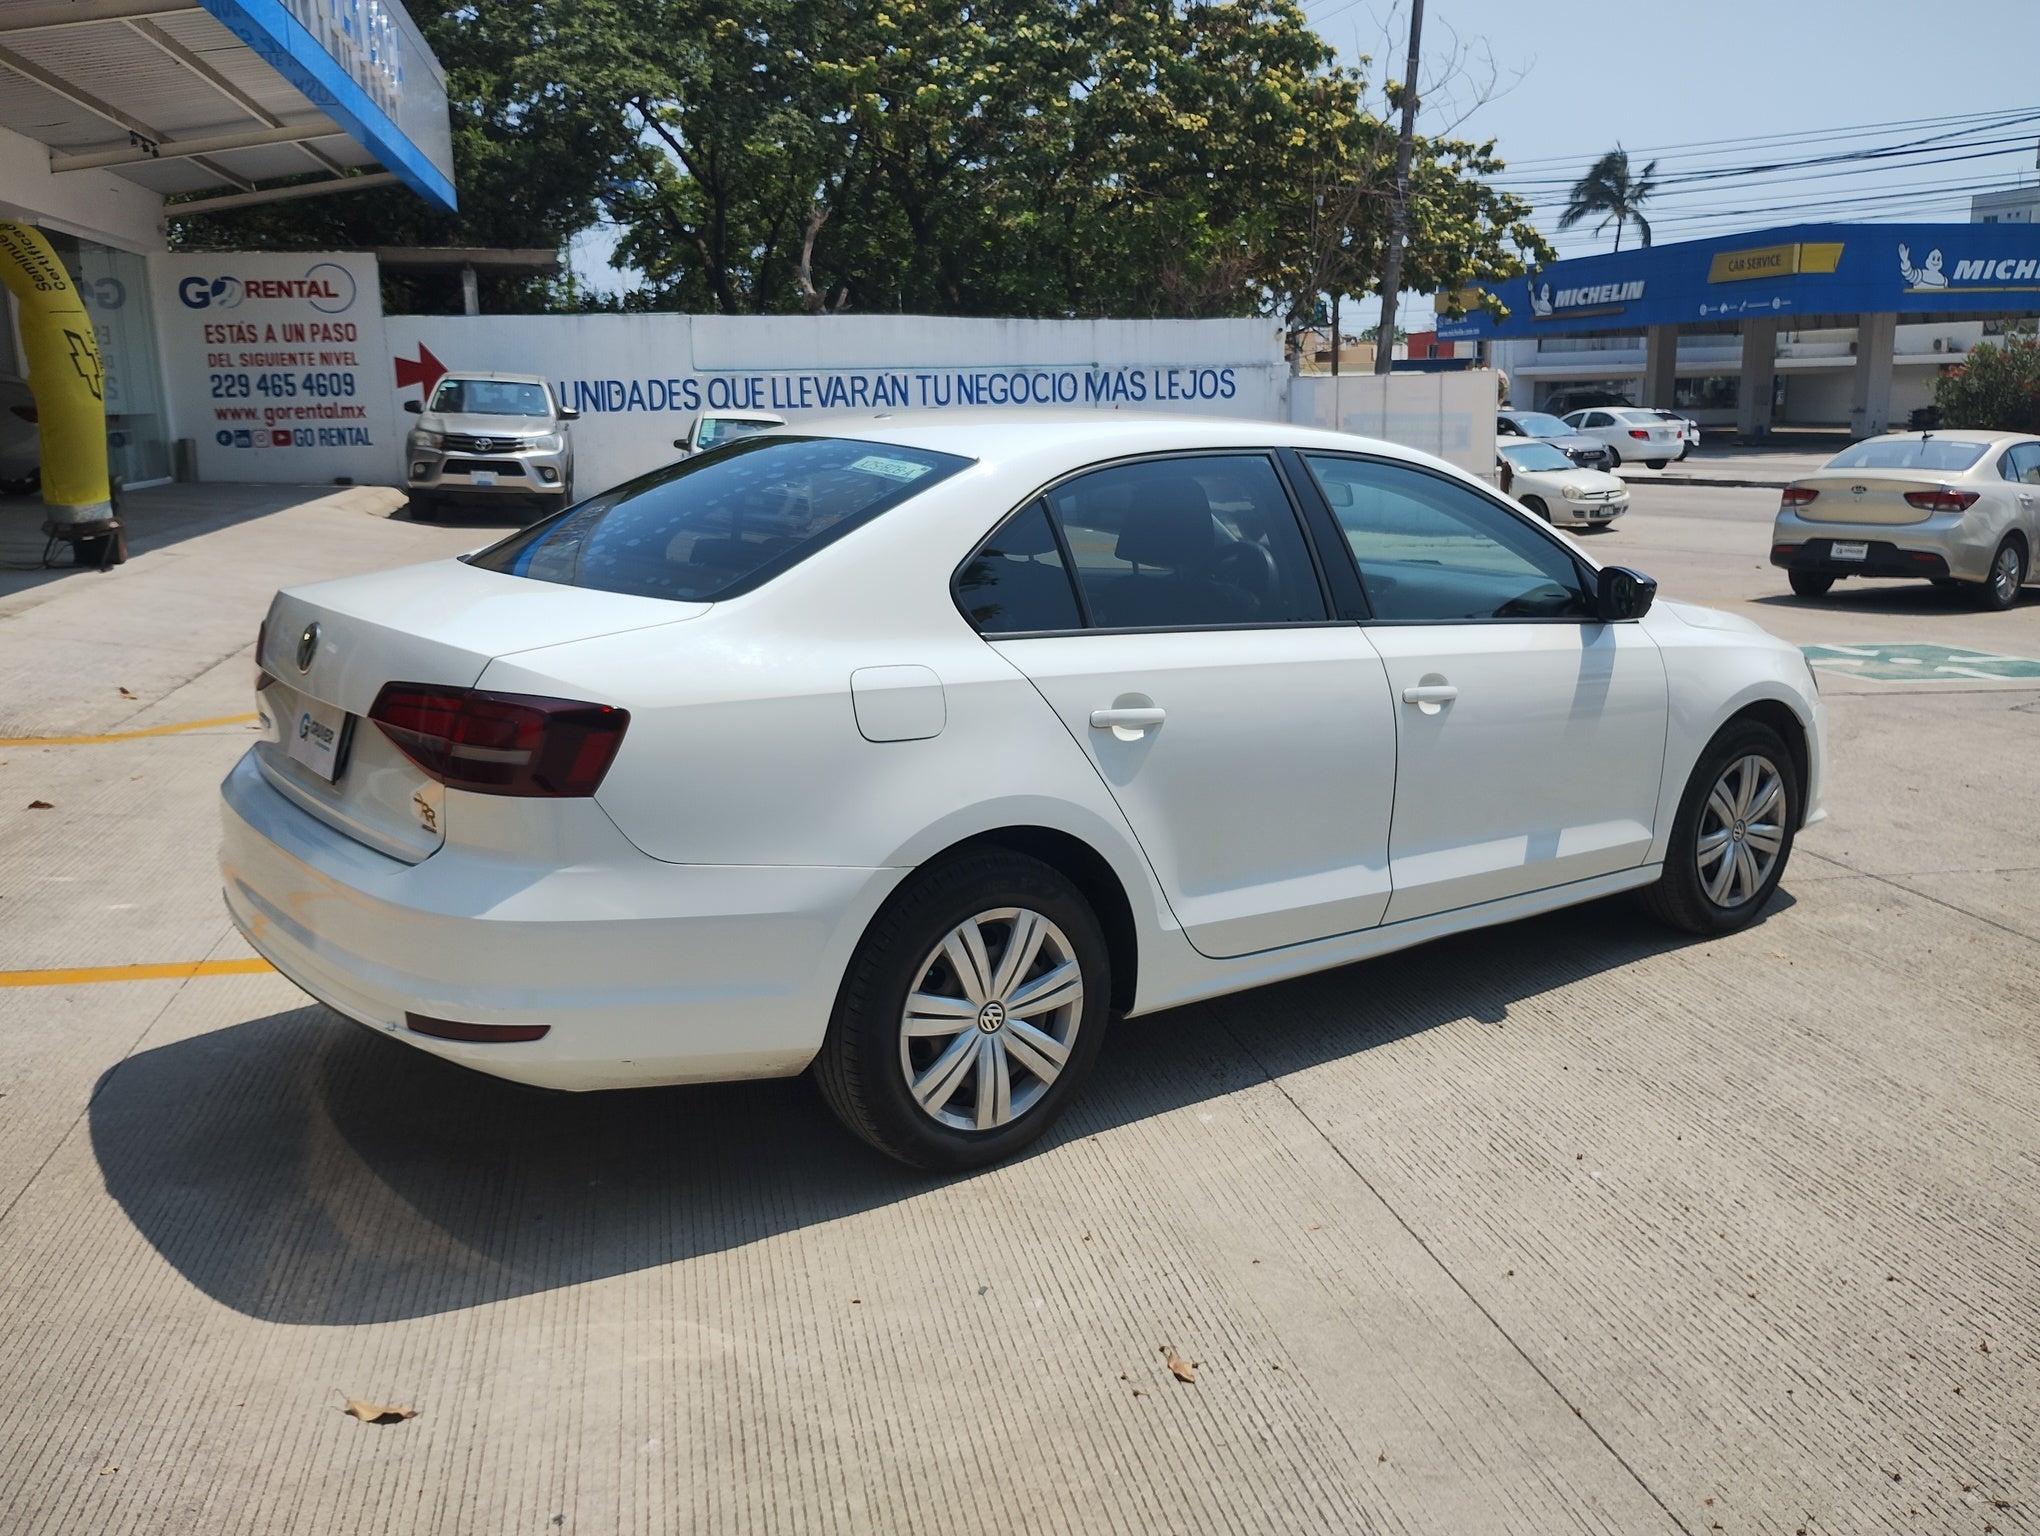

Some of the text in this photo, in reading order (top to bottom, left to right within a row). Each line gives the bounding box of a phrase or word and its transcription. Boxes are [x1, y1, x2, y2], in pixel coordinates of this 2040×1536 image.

[1728, 254, 1782, 272] CAR SERVICE
[1952, 259, 2040, 281] MICH
[245, 280, 340, 299] RENTAL
[1554, 280, 1646, 308] MICHELIN
[264, 323, 278, 344] A
[282, 323, 306, 343] UN
[310, 322, 358, 342] PASO
[207, 351, 360, 368] DEL SIGUIENTE NIVEL
[210, 372, 356, 398] 229 465 4609
[560, 378, 701, 413] UNIDADES
[708, 376, 766, 410] QUE
[916, 374, 951, 406] TU
[957, 372, 1079, 405] NEGOCIO
[1084, 366, 1148, 402] MÁS
[1154, 368, 1237, 400] LEJOS
[293, 426, 374, 447] GO RENTAL
